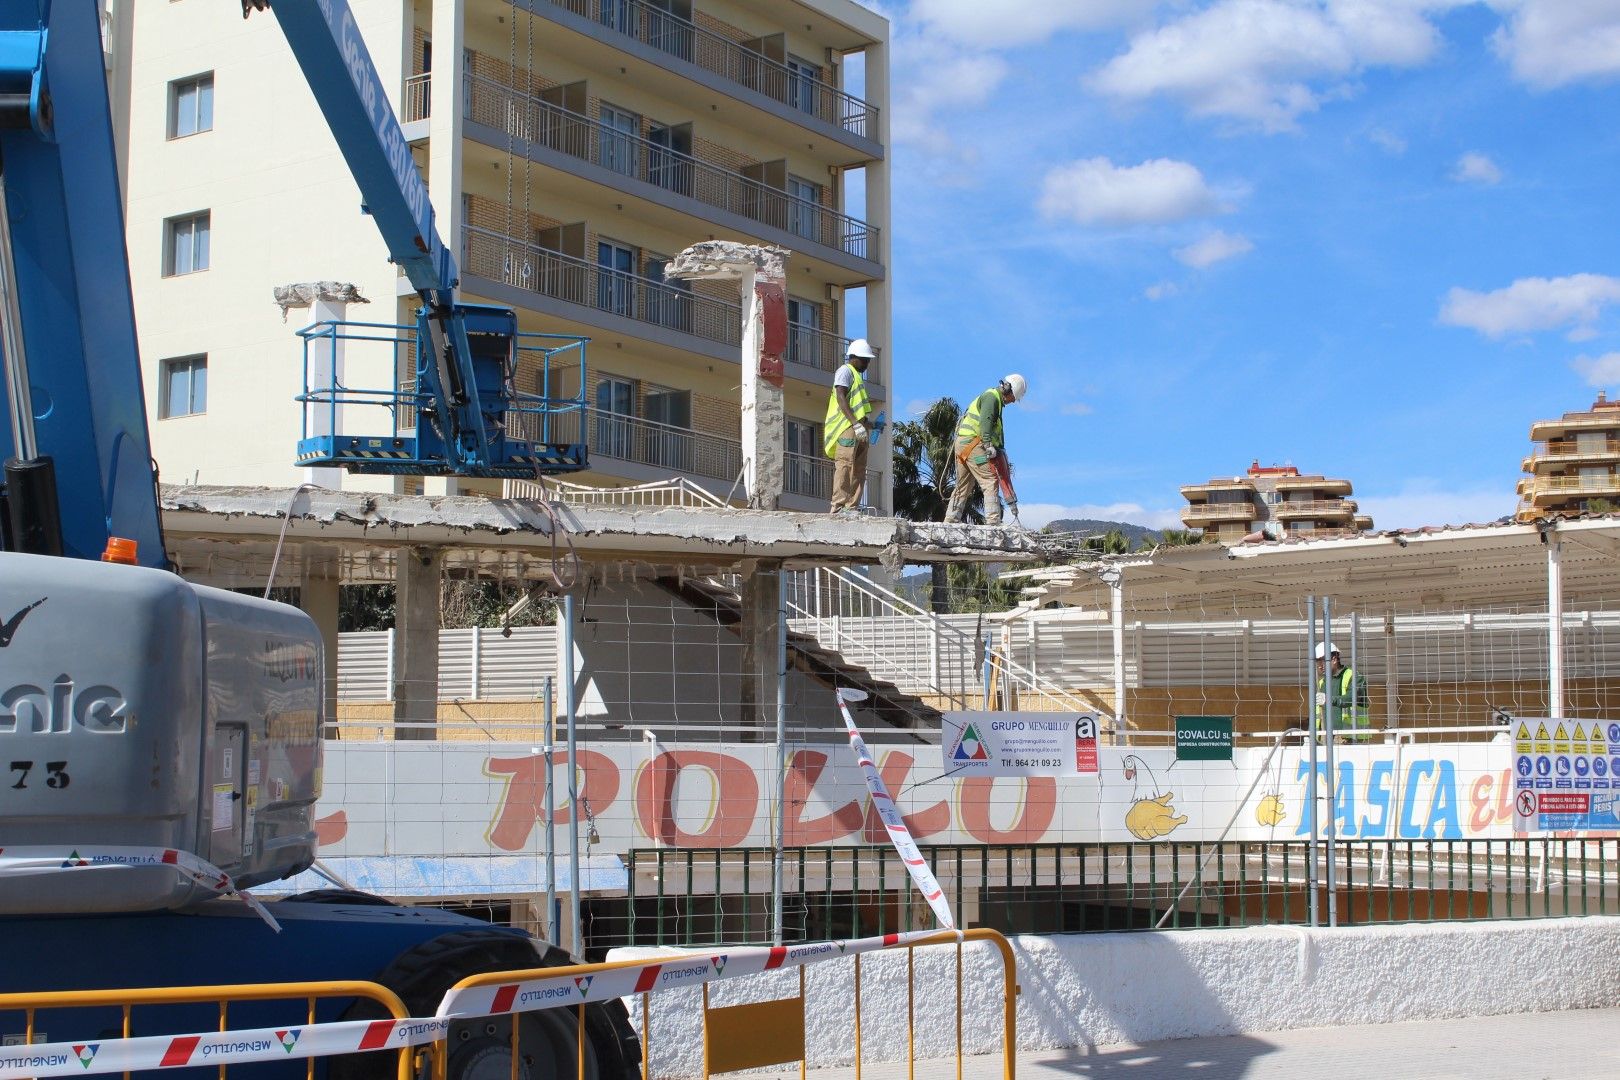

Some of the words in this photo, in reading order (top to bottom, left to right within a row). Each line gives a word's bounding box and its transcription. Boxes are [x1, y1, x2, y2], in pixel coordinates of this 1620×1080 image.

[0, 672, 127, 734] nie
[991, 721, 1025, 731] GRUPO
[1177, 730, 1221, 740] COVALCU
[1015, 759, 1029, 767] 964
[1030, 759, 1039, 767] 21
[1041, 759, 1051, 767] 09
[1052, 759, 1062, 767] 23
[482, 748, 1058, 850] POLLO
[1293, 758, 1464, 840] TASCA
[662, 965, 709, 984] MENGUILLÓ
[520, 986, 571, 1004] MENGUILLÓ
[398, 1020, 449, 1040] ENGUILLÓ
[203, 1040, 271, 1058] MENGUILLÓ
